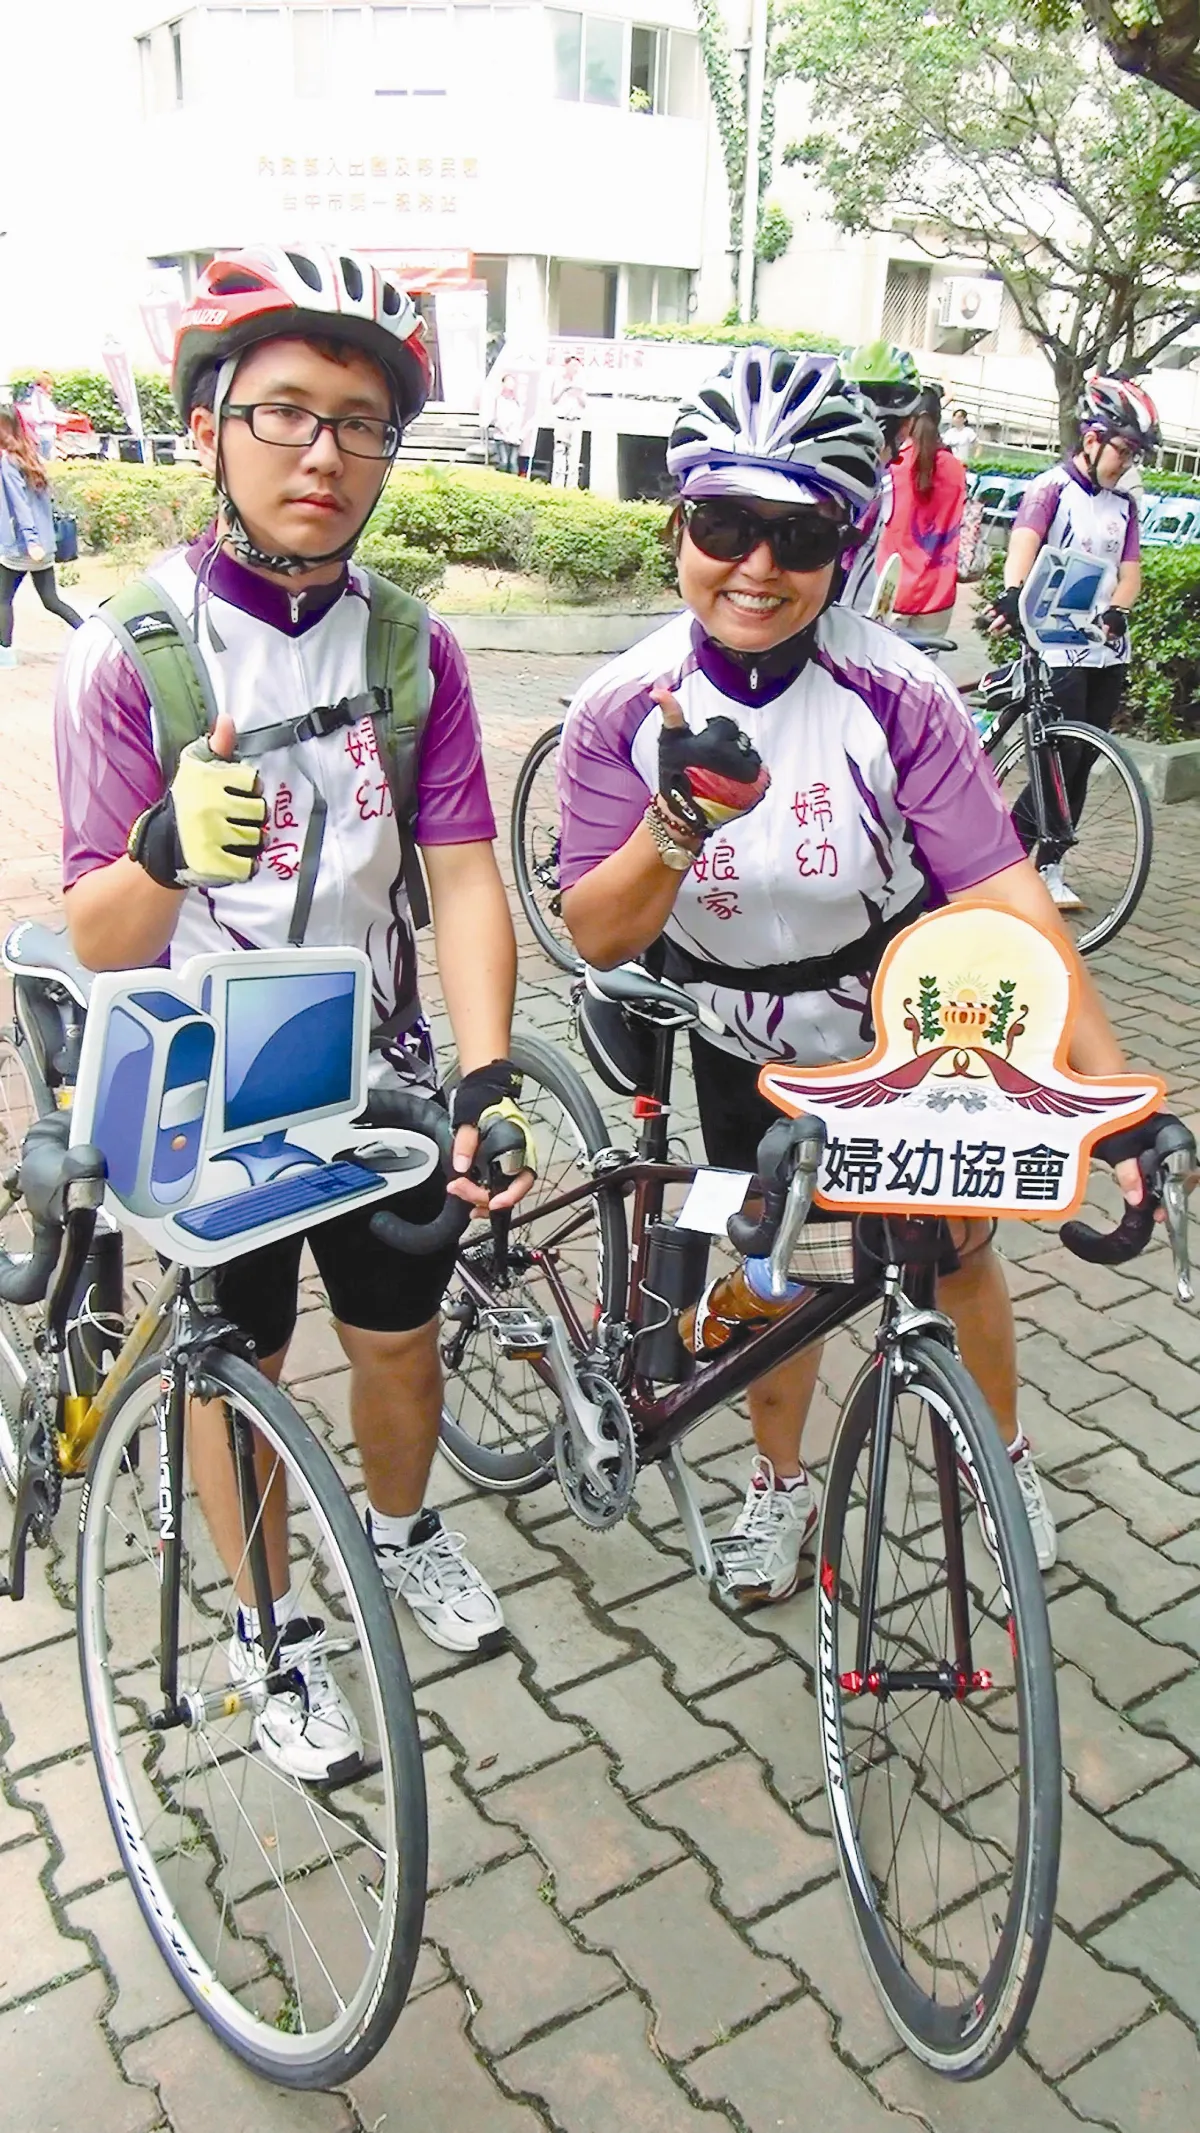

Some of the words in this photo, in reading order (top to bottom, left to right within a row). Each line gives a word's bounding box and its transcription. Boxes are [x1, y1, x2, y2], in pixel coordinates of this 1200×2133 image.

[790, 782, 838, 877] 婦幼
[693, 838, 742, 920] 娘家
[822, 1136, 1071, 1201] 婦幼協會
